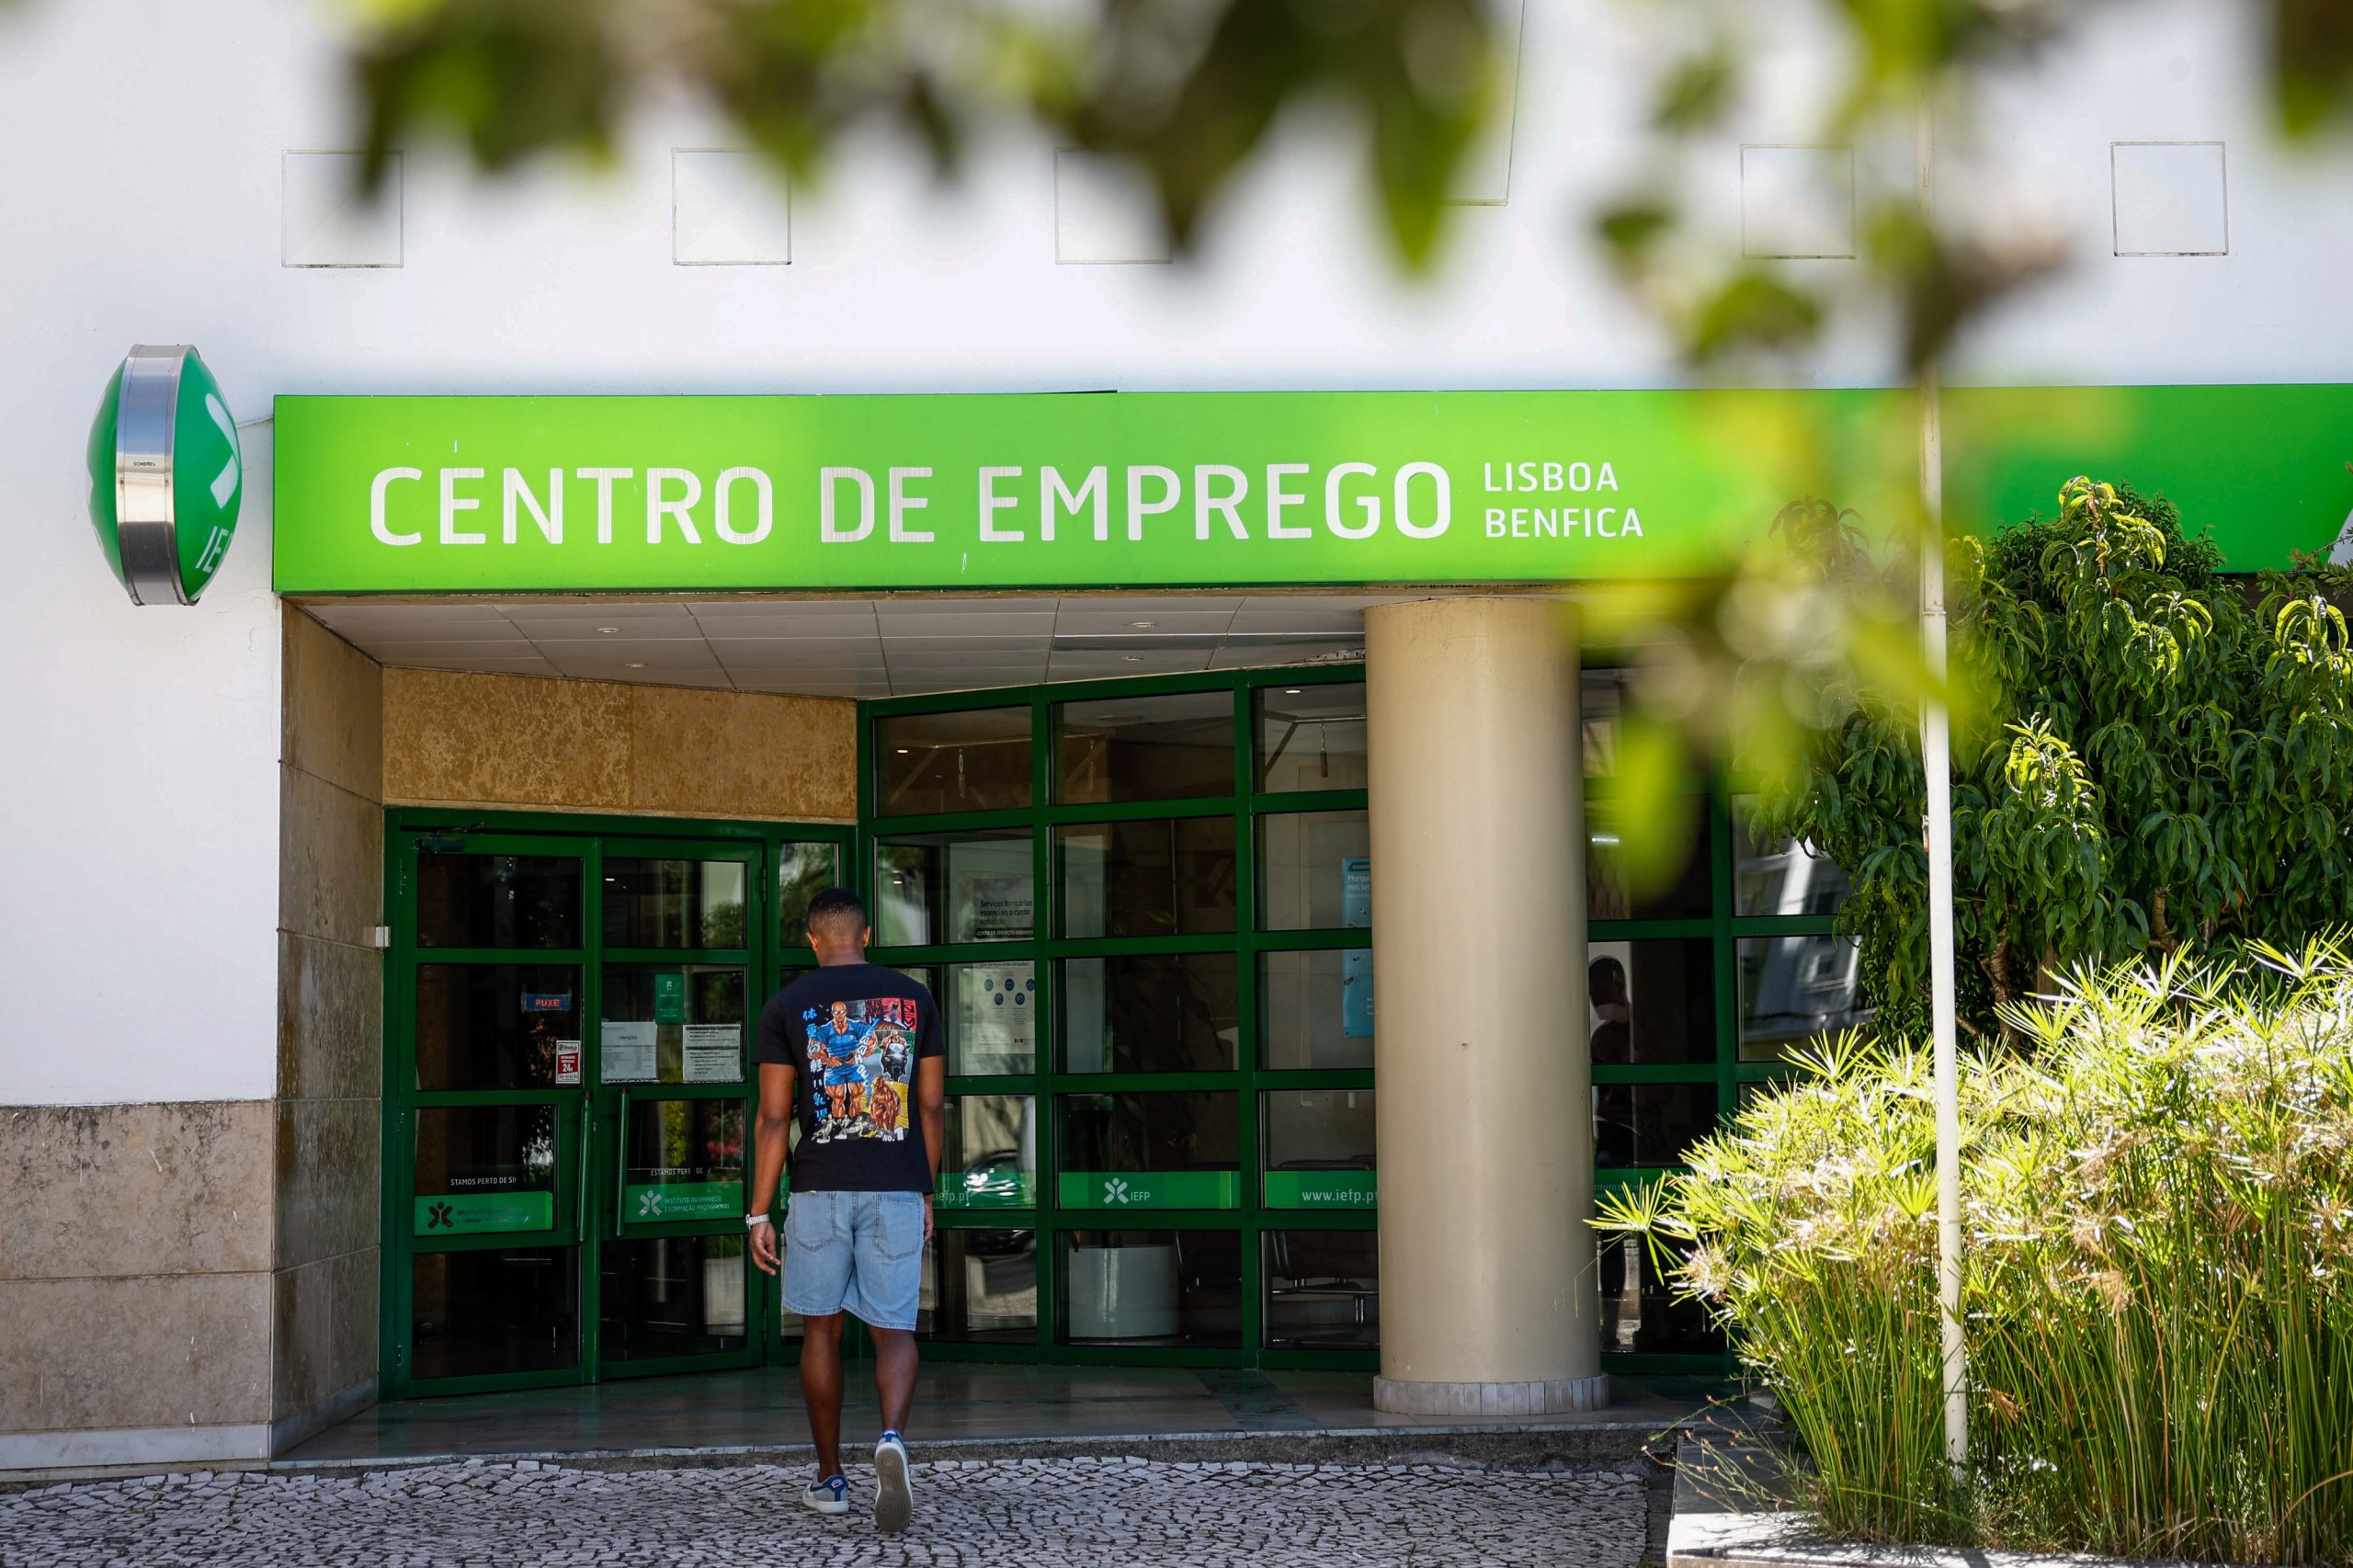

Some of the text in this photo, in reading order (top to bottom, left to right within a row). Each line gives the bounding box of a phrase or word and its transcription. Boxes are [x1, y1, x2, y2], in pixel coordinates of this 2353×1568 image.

[1483, 462, 1620, 492] LISBOA
[369, 461, 1451, 546] CENTRO DE EMPREGO
[1484, 507, 1643, 538] BENFICA
[535, 999, 560, 1007] PUXE
[650, 1168, 676, 1176] ESTAMOS
[477, 1176, 498, 1185] PERTO
[1131, 1192, 1151, 1201] IEFP
[669, 1203, 696, 1213] FORMAÇÃO
